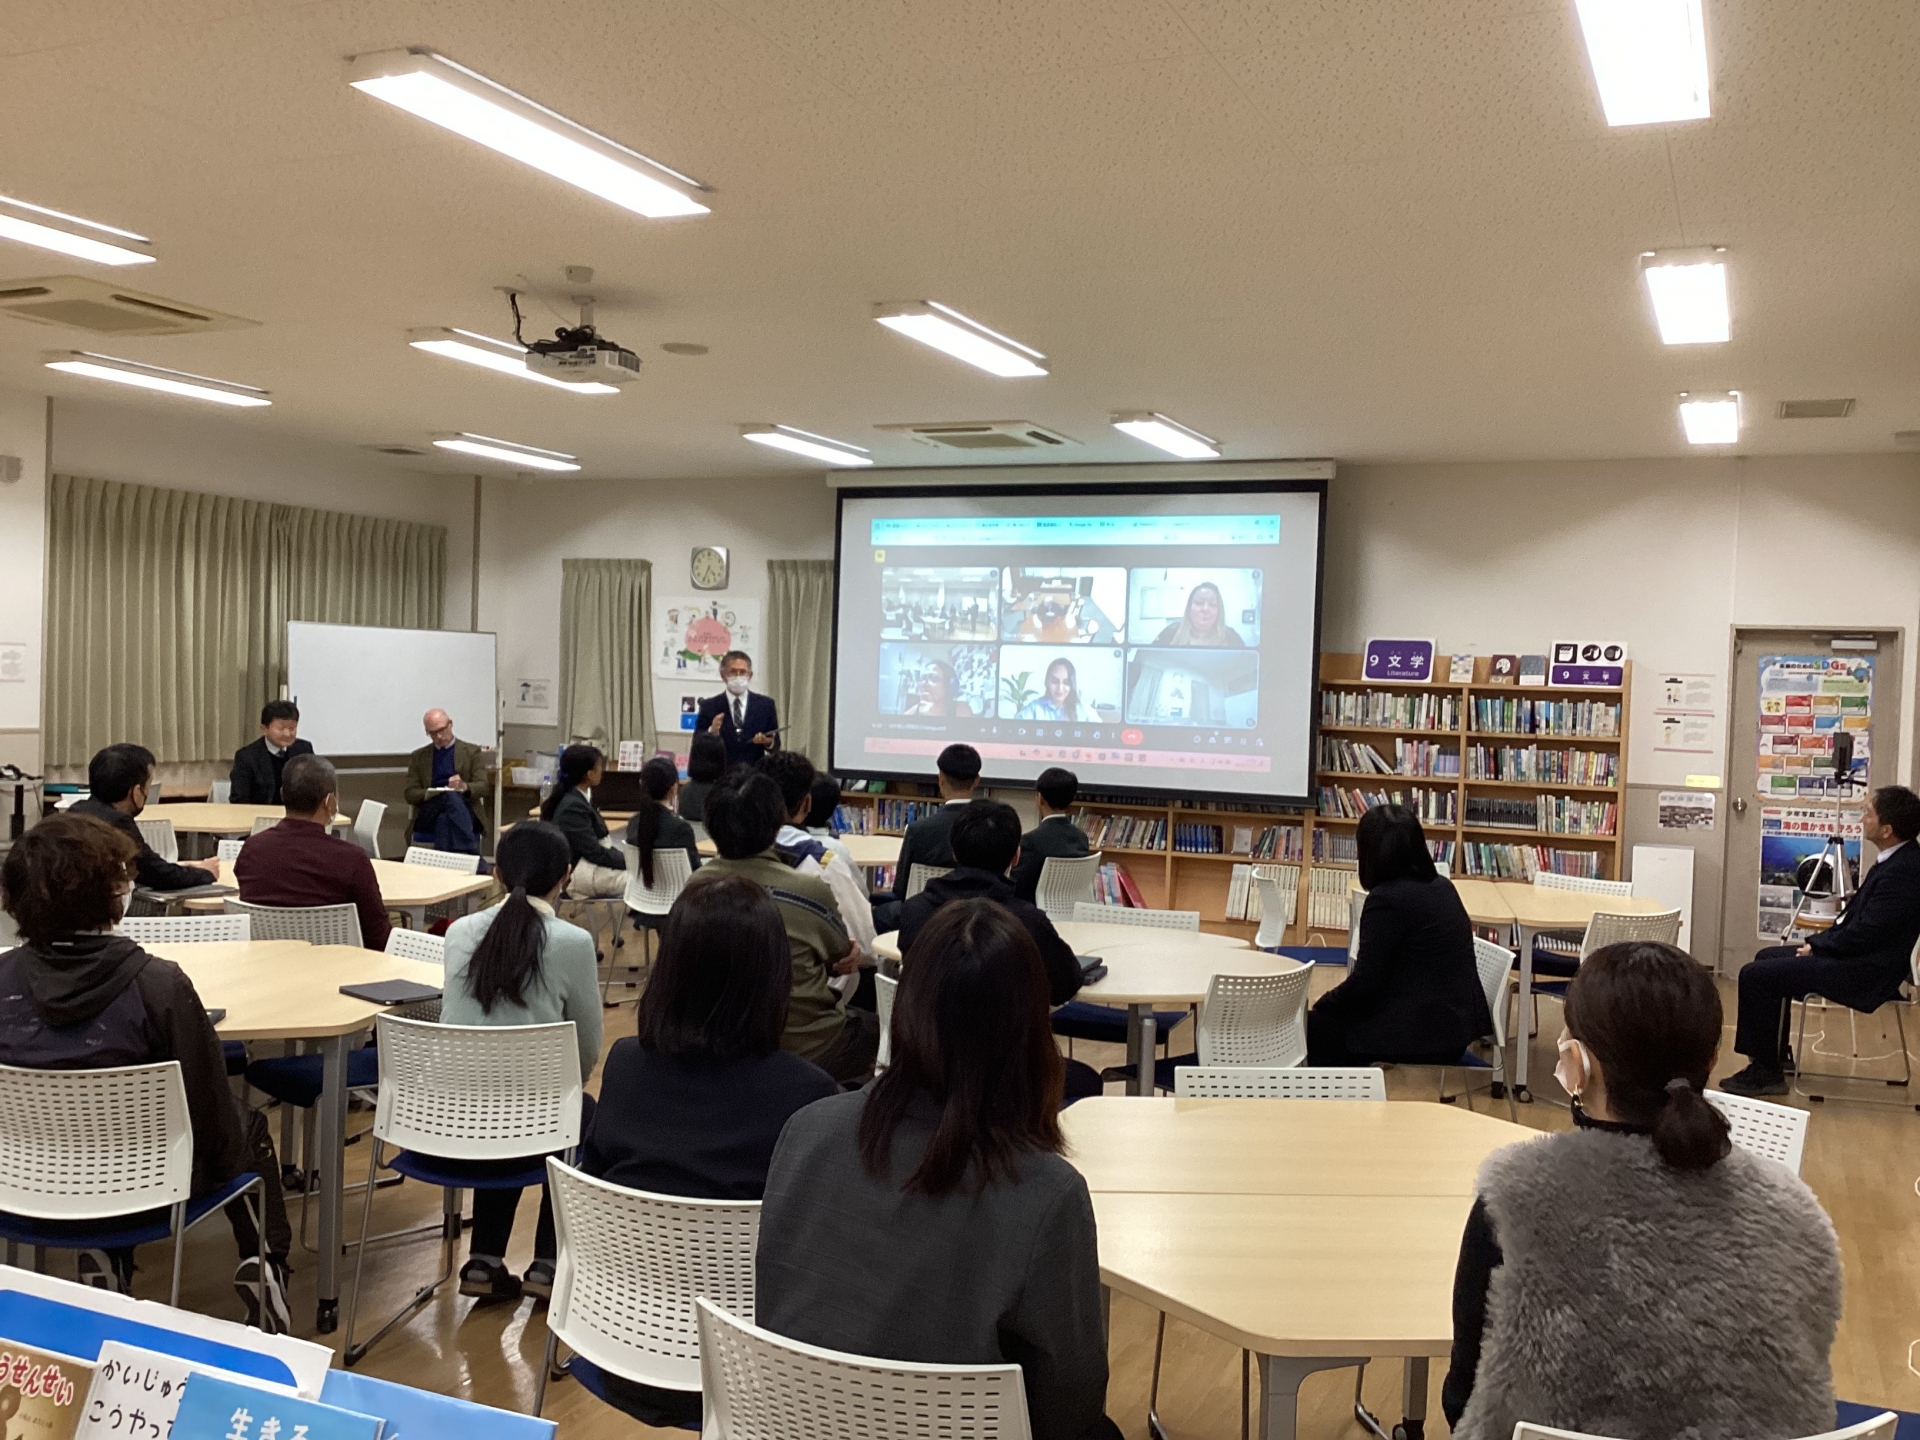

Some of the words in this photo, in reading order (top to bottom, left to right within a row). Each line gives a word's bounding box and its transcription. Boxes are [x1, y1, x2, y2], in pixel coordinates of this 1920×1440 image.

[1370, 655, 1379, 667] 9
[1388, 655, 1424, 669] 文学
[1562, 670, 1570, 680] 9
[0, 1355, 73, 1403] うせんせい
